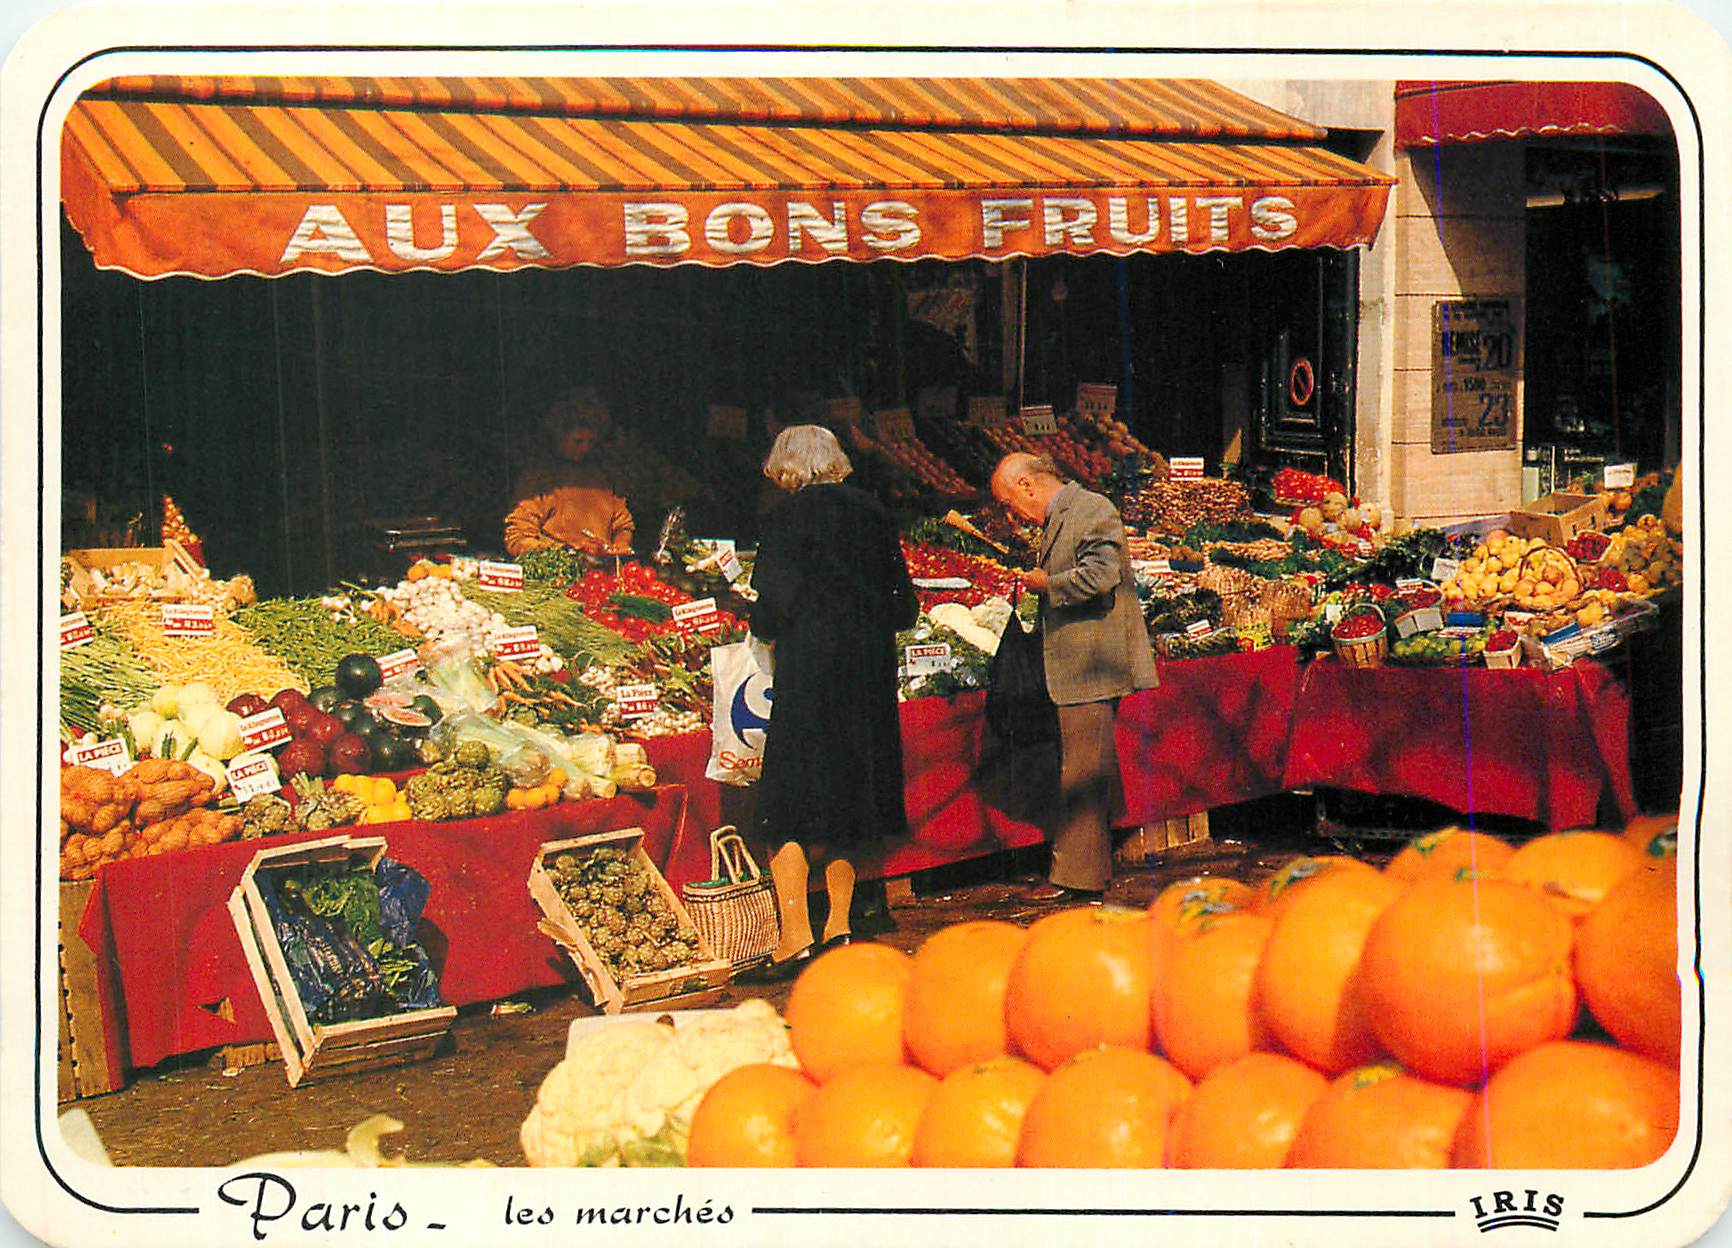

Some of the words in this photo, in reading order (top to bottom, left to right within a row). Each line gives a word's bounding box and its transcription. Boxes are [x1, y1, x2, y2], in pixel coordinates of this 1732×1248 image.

[279, 203, 553, 264] AUX
[624, 200, 922, 255] BONS
[981, 196, 1298, 249] FRUITS
[79, 750, 94, 763] LA
